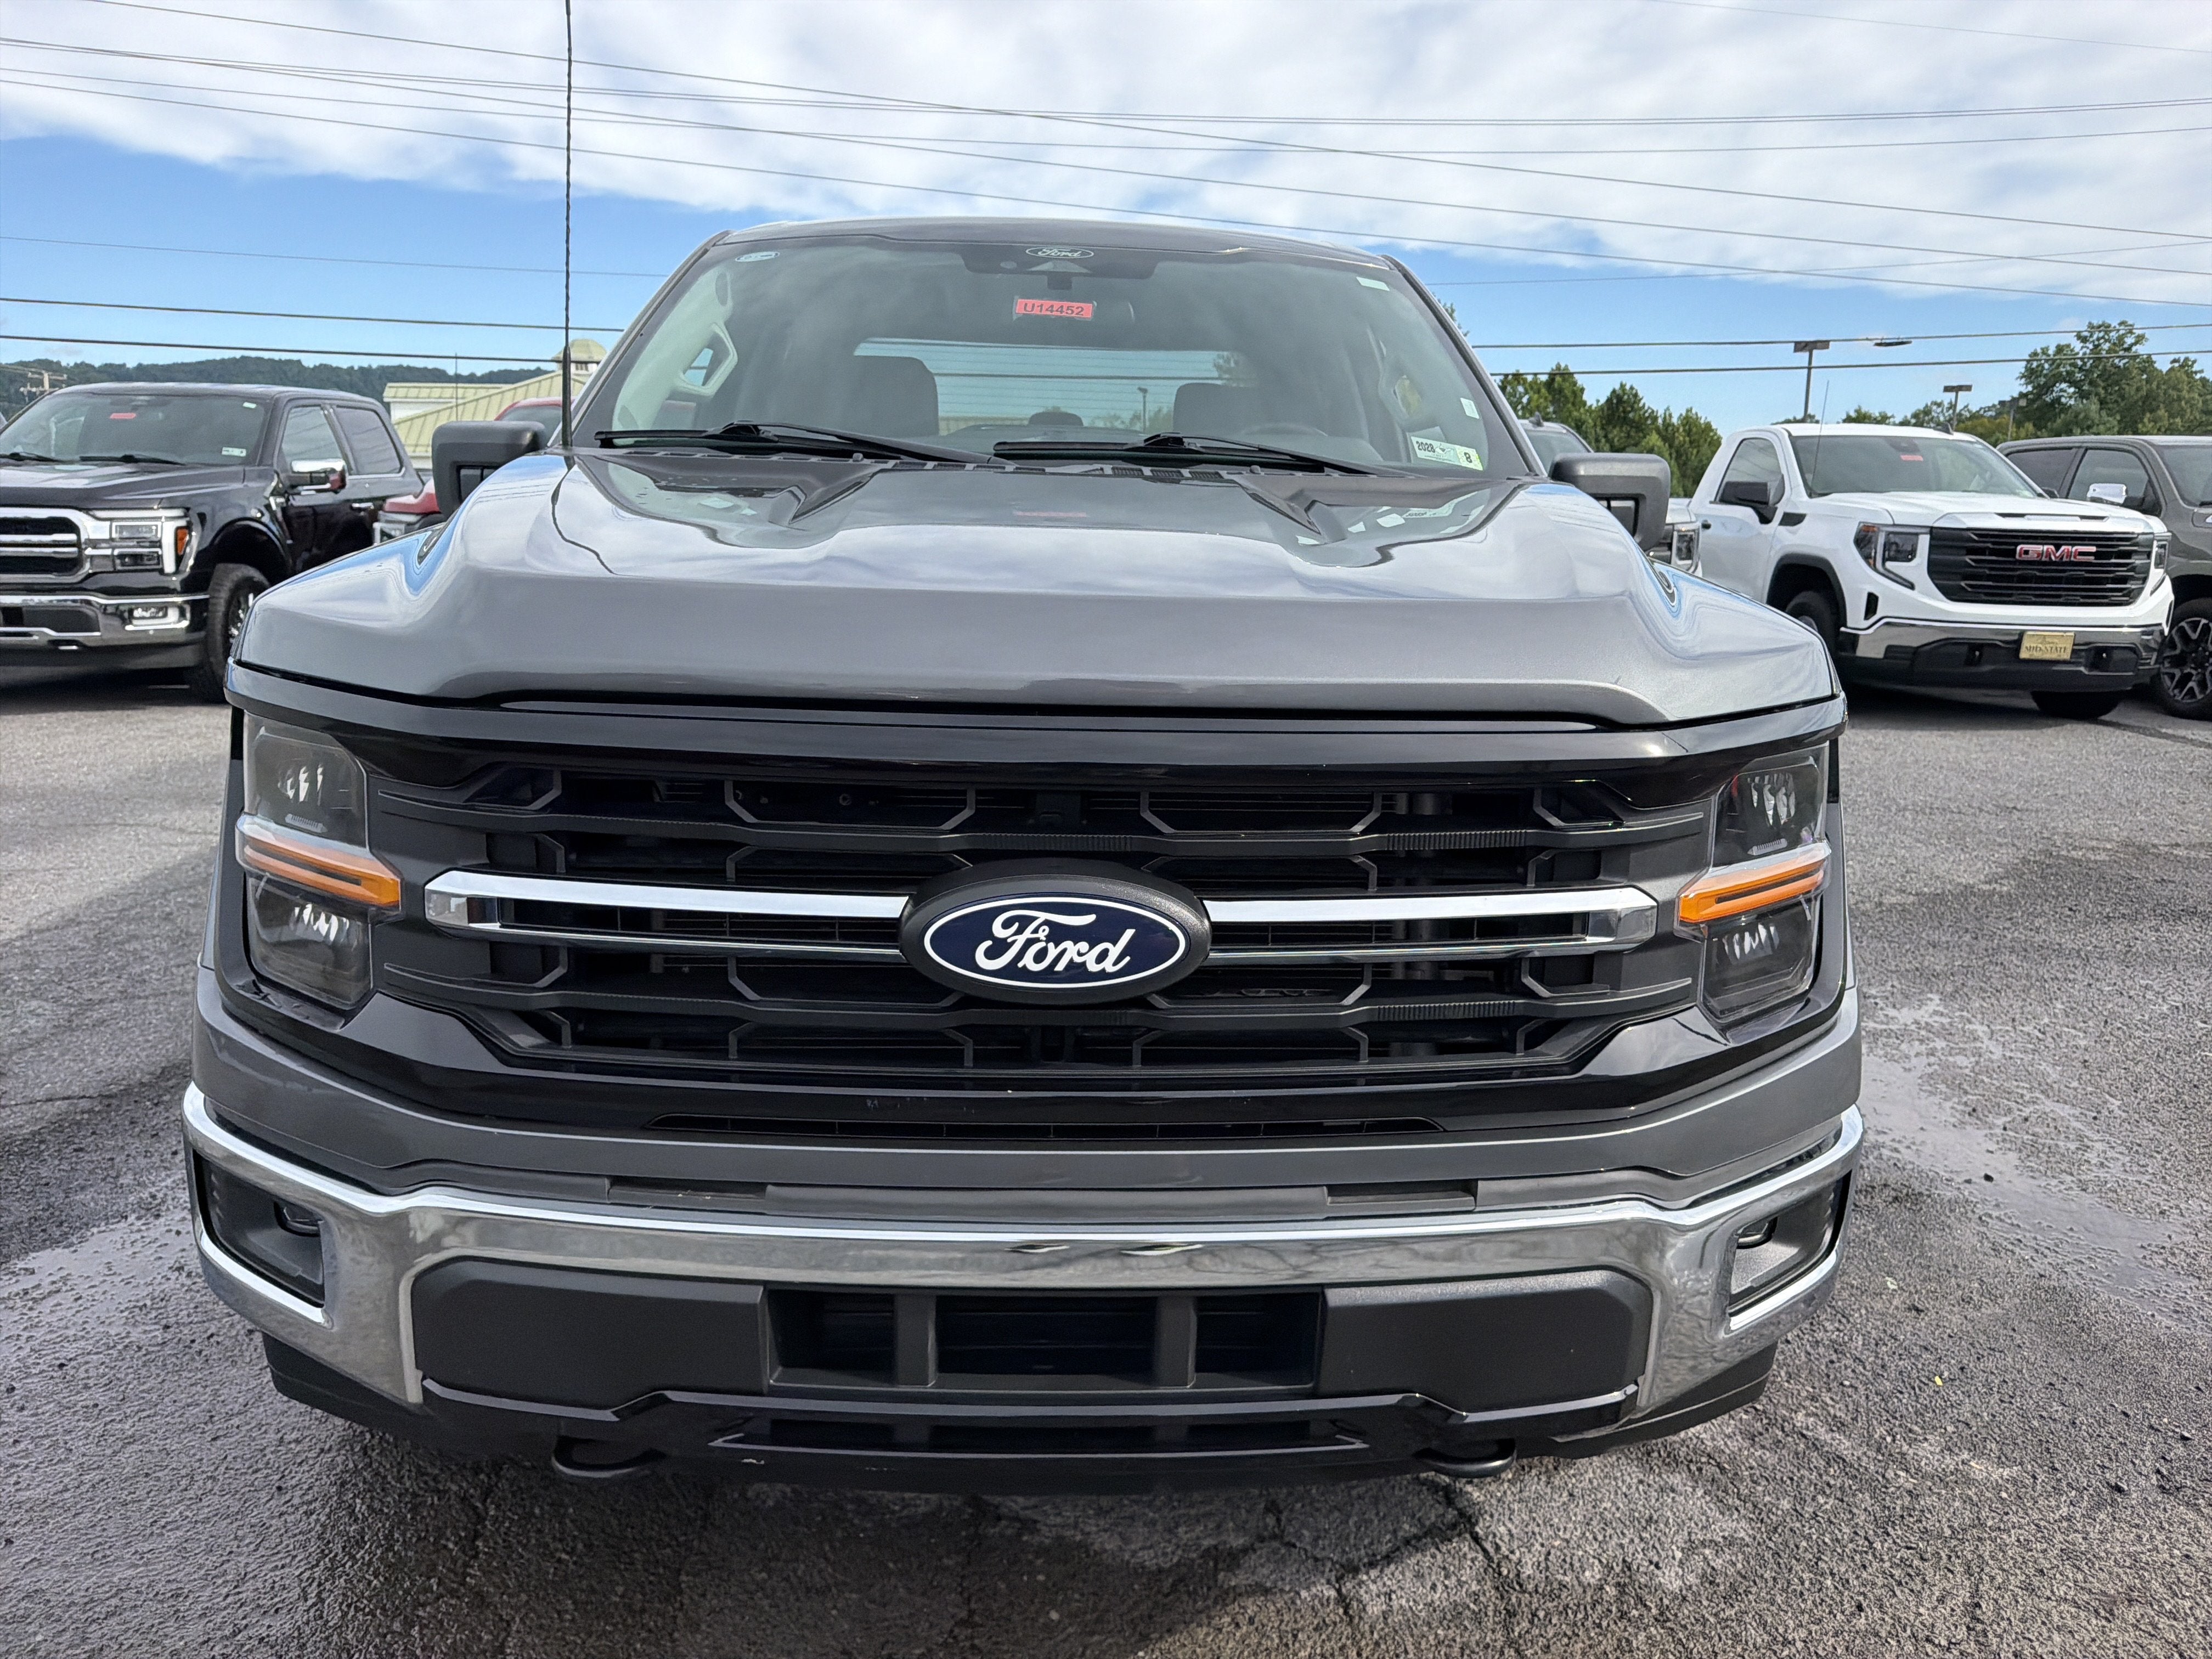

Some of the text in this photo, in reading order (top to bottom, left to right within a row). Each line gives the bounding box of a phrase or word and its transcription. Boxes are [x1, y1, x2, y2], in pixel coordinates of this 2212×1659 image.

[1038, 248, 1081, 257] Ford
[1024, 302, 1085, 317] U14452
[1415, 441, 1436, 453] 2028
[1464, 452, 1473, 464] 8
[2016, 544, 2097, 562] GMC
[975, 910, 1136, 973] Ford
